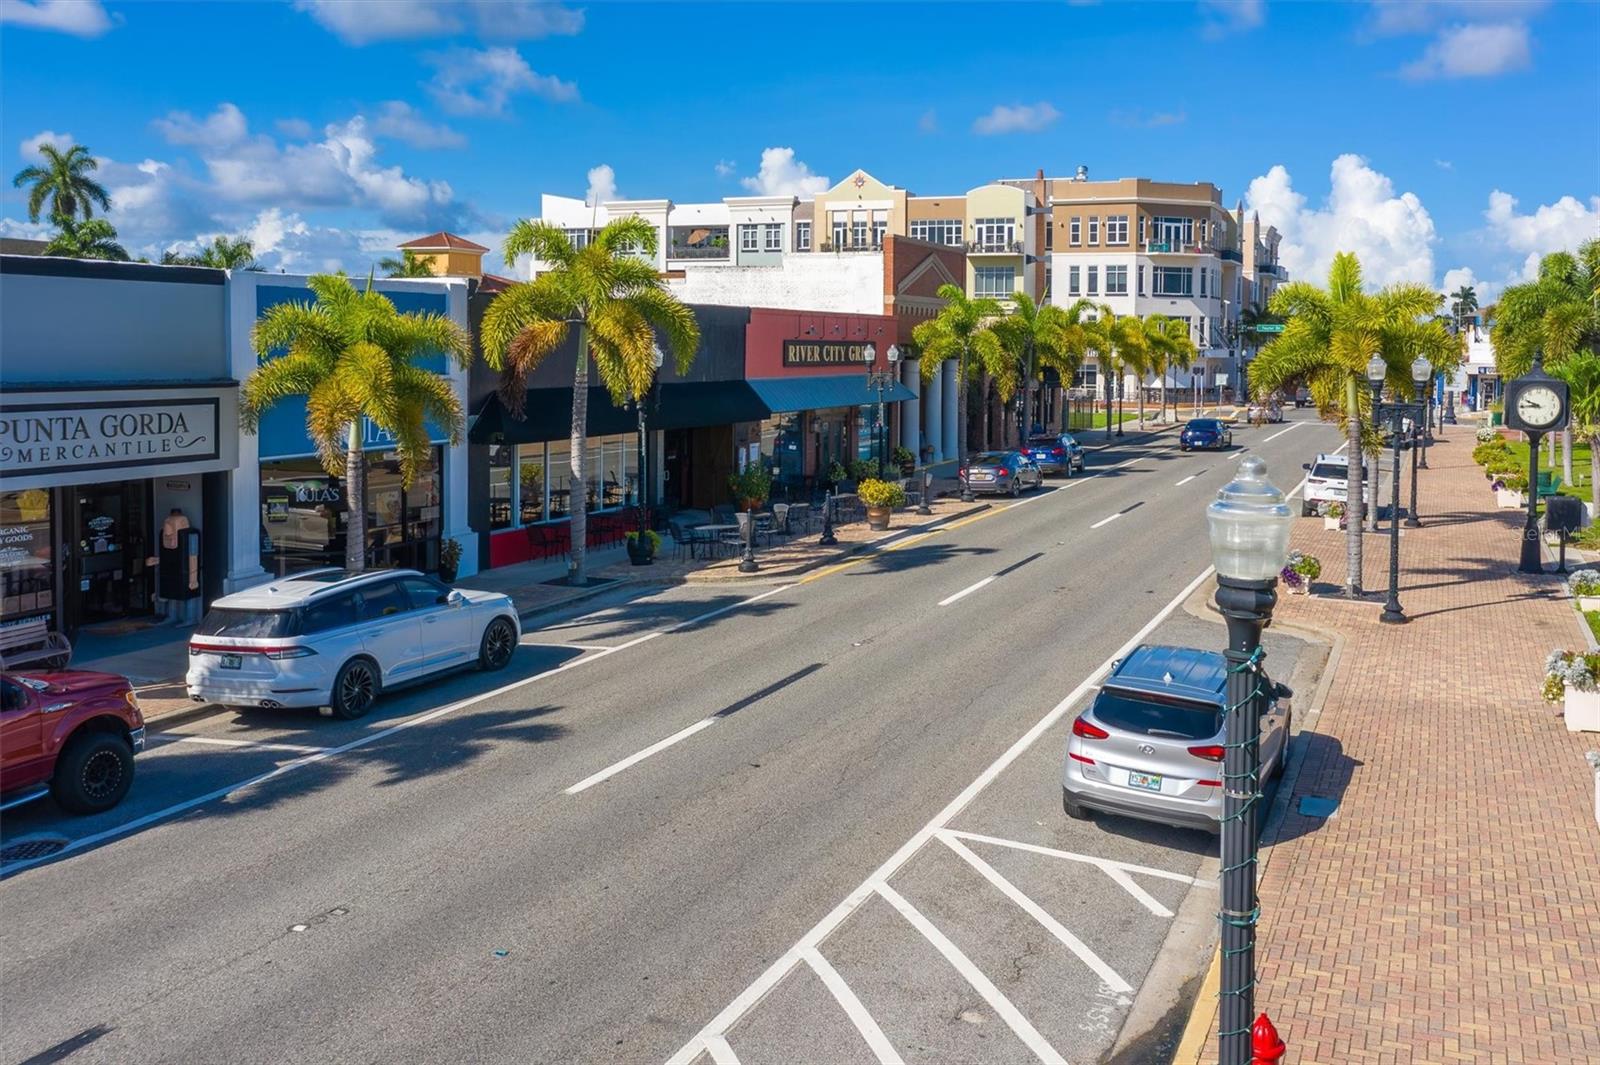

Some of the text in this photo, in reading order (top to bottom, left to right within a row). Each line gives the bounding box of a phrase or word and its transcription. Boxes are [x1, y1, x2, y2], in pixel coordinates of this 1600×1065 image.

[788, 345, 867, 362] RIVER CITY GRI
[0, 412, 190, 444] PUNTA GORDA
[17, 439, 171, 464] MERCANTILE
[5, 533, 33, 543] GOODS
